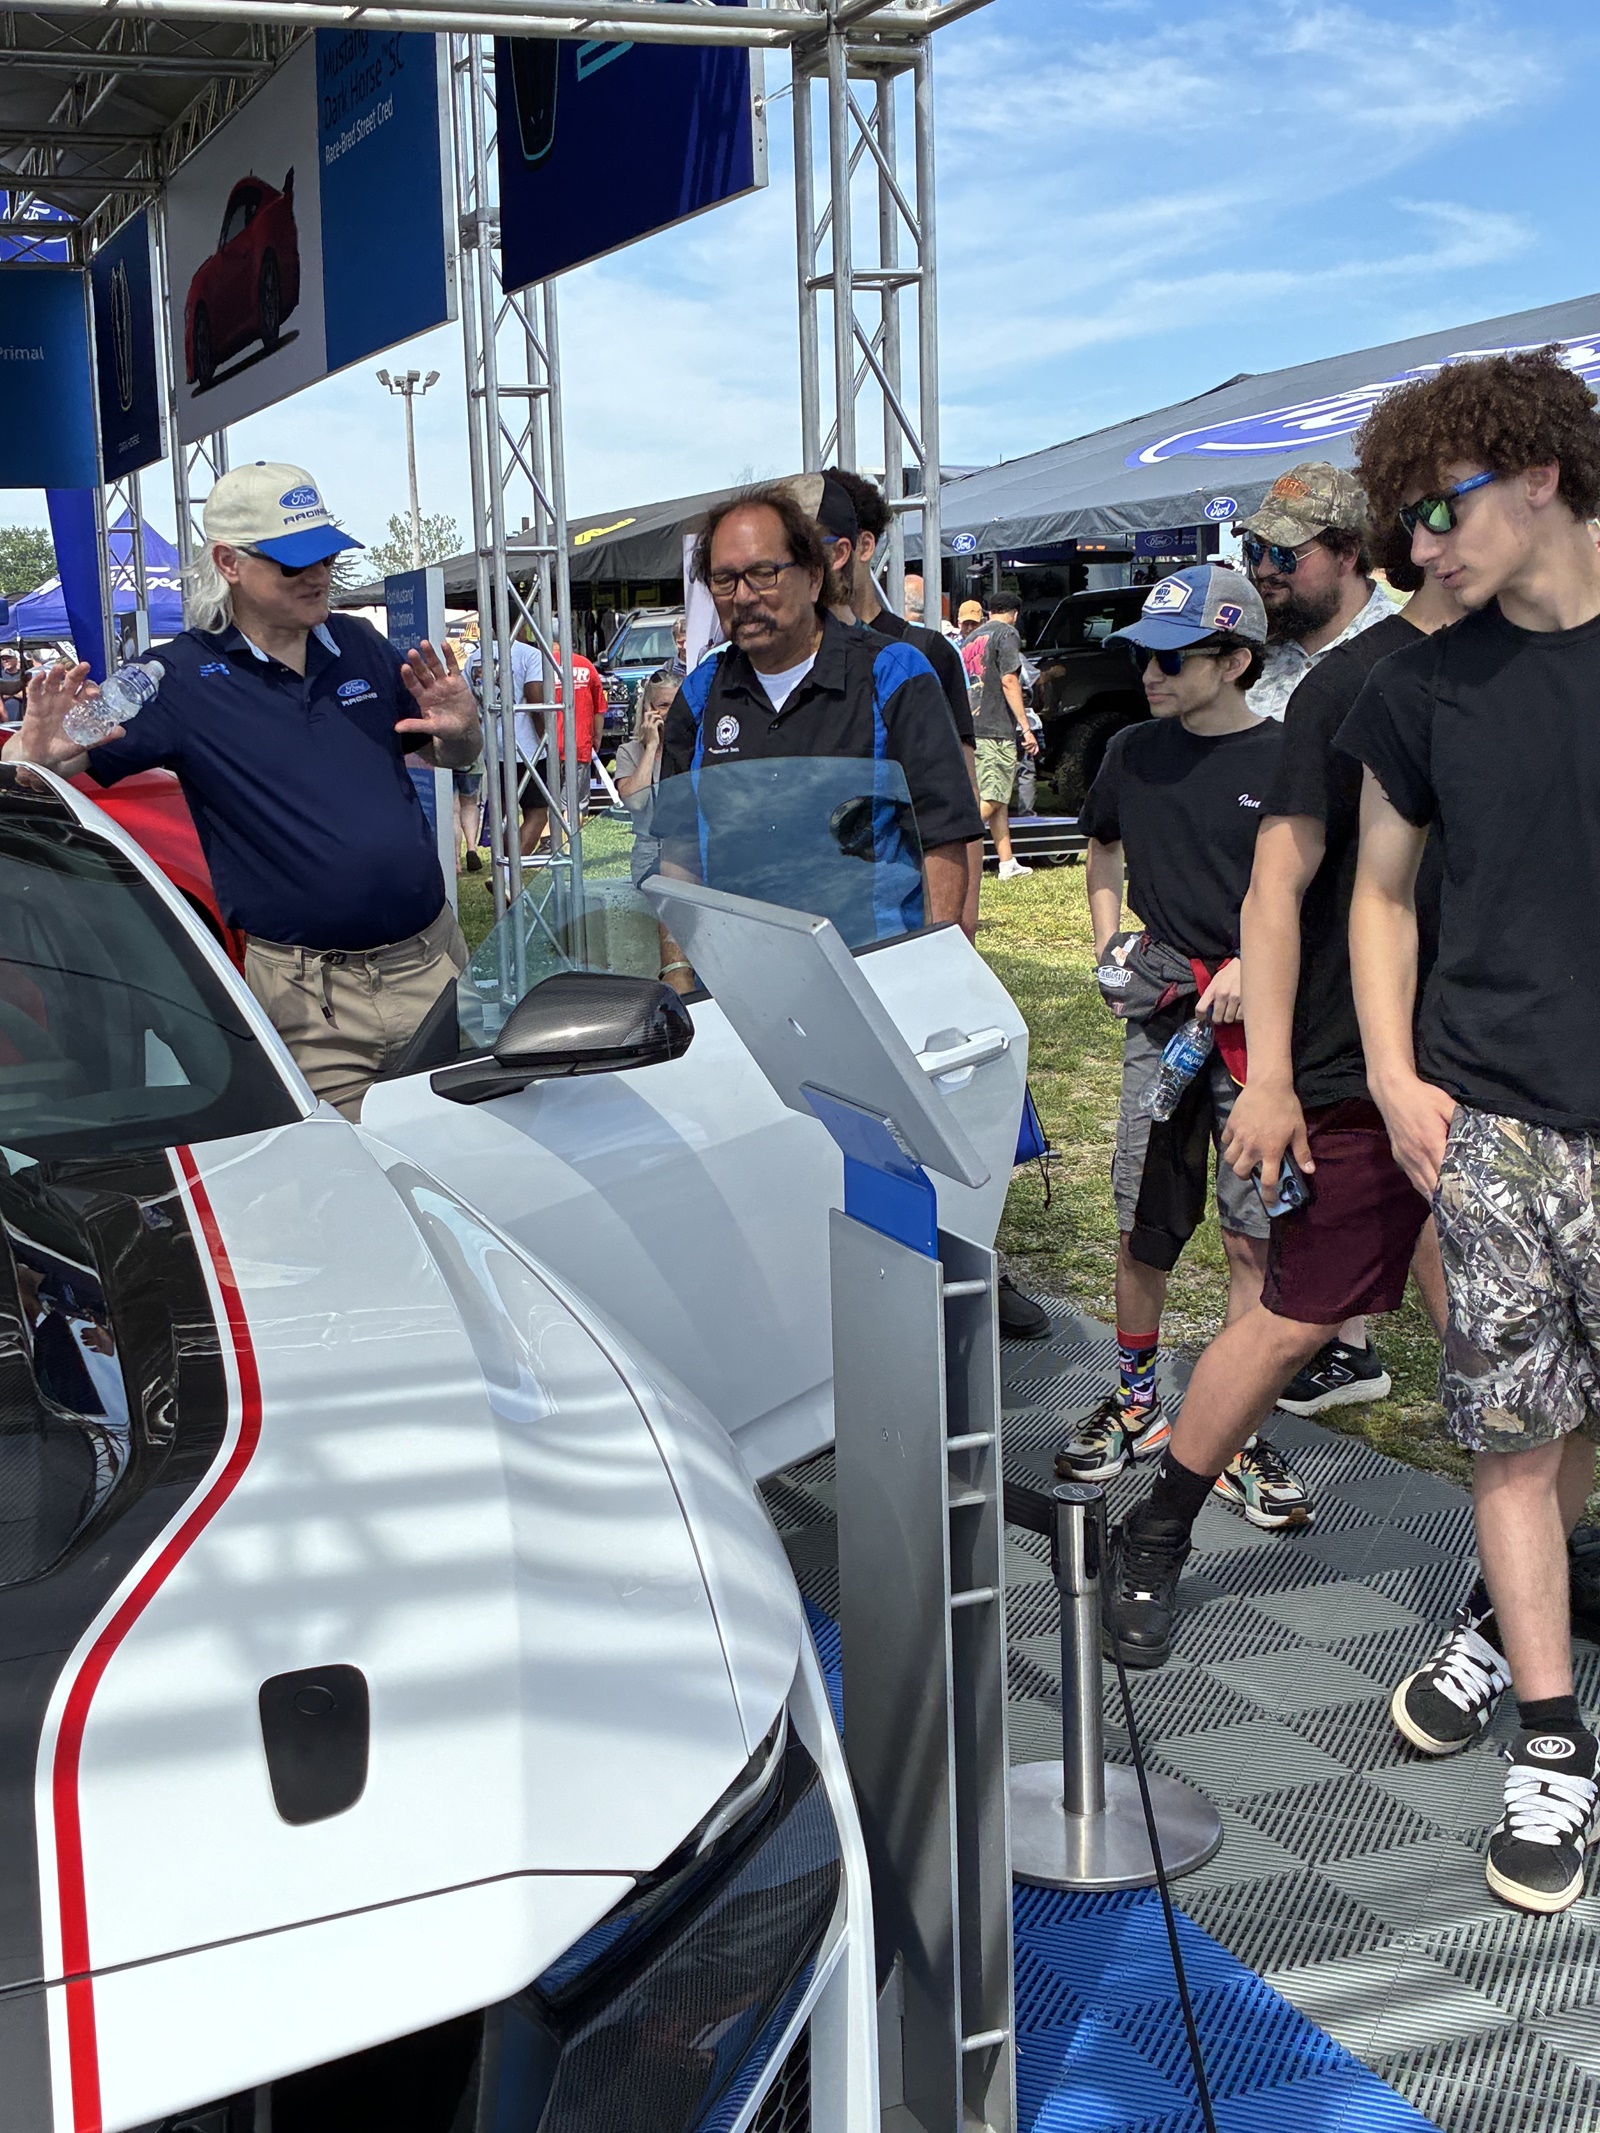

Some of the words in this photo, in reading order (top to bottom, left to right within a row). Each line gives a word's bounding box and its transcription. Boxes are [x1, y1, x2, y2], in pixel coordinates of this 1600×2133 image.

[324, 79, 347, 131] Dark
[325, 123, 356, 166] Race-Bred
[356, 107, 376, 142] Street
[377, 92, 393, 125] Cred
[1210, 500, 1231, 517] Ford
[956, 536, 972, 550] Ford
[1215, 603, 1243, 629] 9
[344, 681, 367, 694] Ford
[341, 692, 378, 707] RACING
[1238, 793, 1261, 808] Ian
